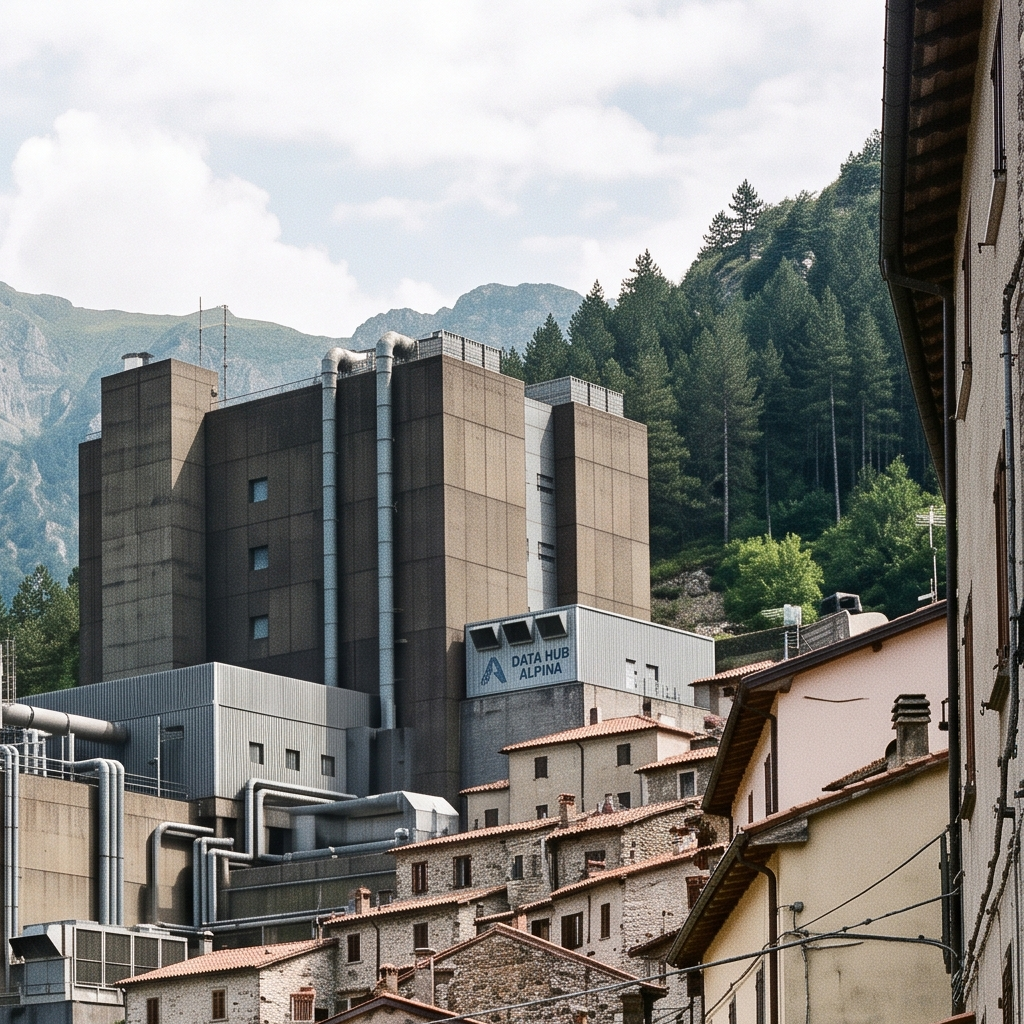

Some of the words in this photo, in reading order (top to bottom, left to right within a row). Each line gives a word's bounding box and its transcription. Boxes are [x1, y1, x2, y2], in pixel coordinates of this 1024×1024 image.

[512, 652, 542, 668] DATA
[545, 647, 570, 662] HUB
[519, 662, 562, 680] ALPINA
